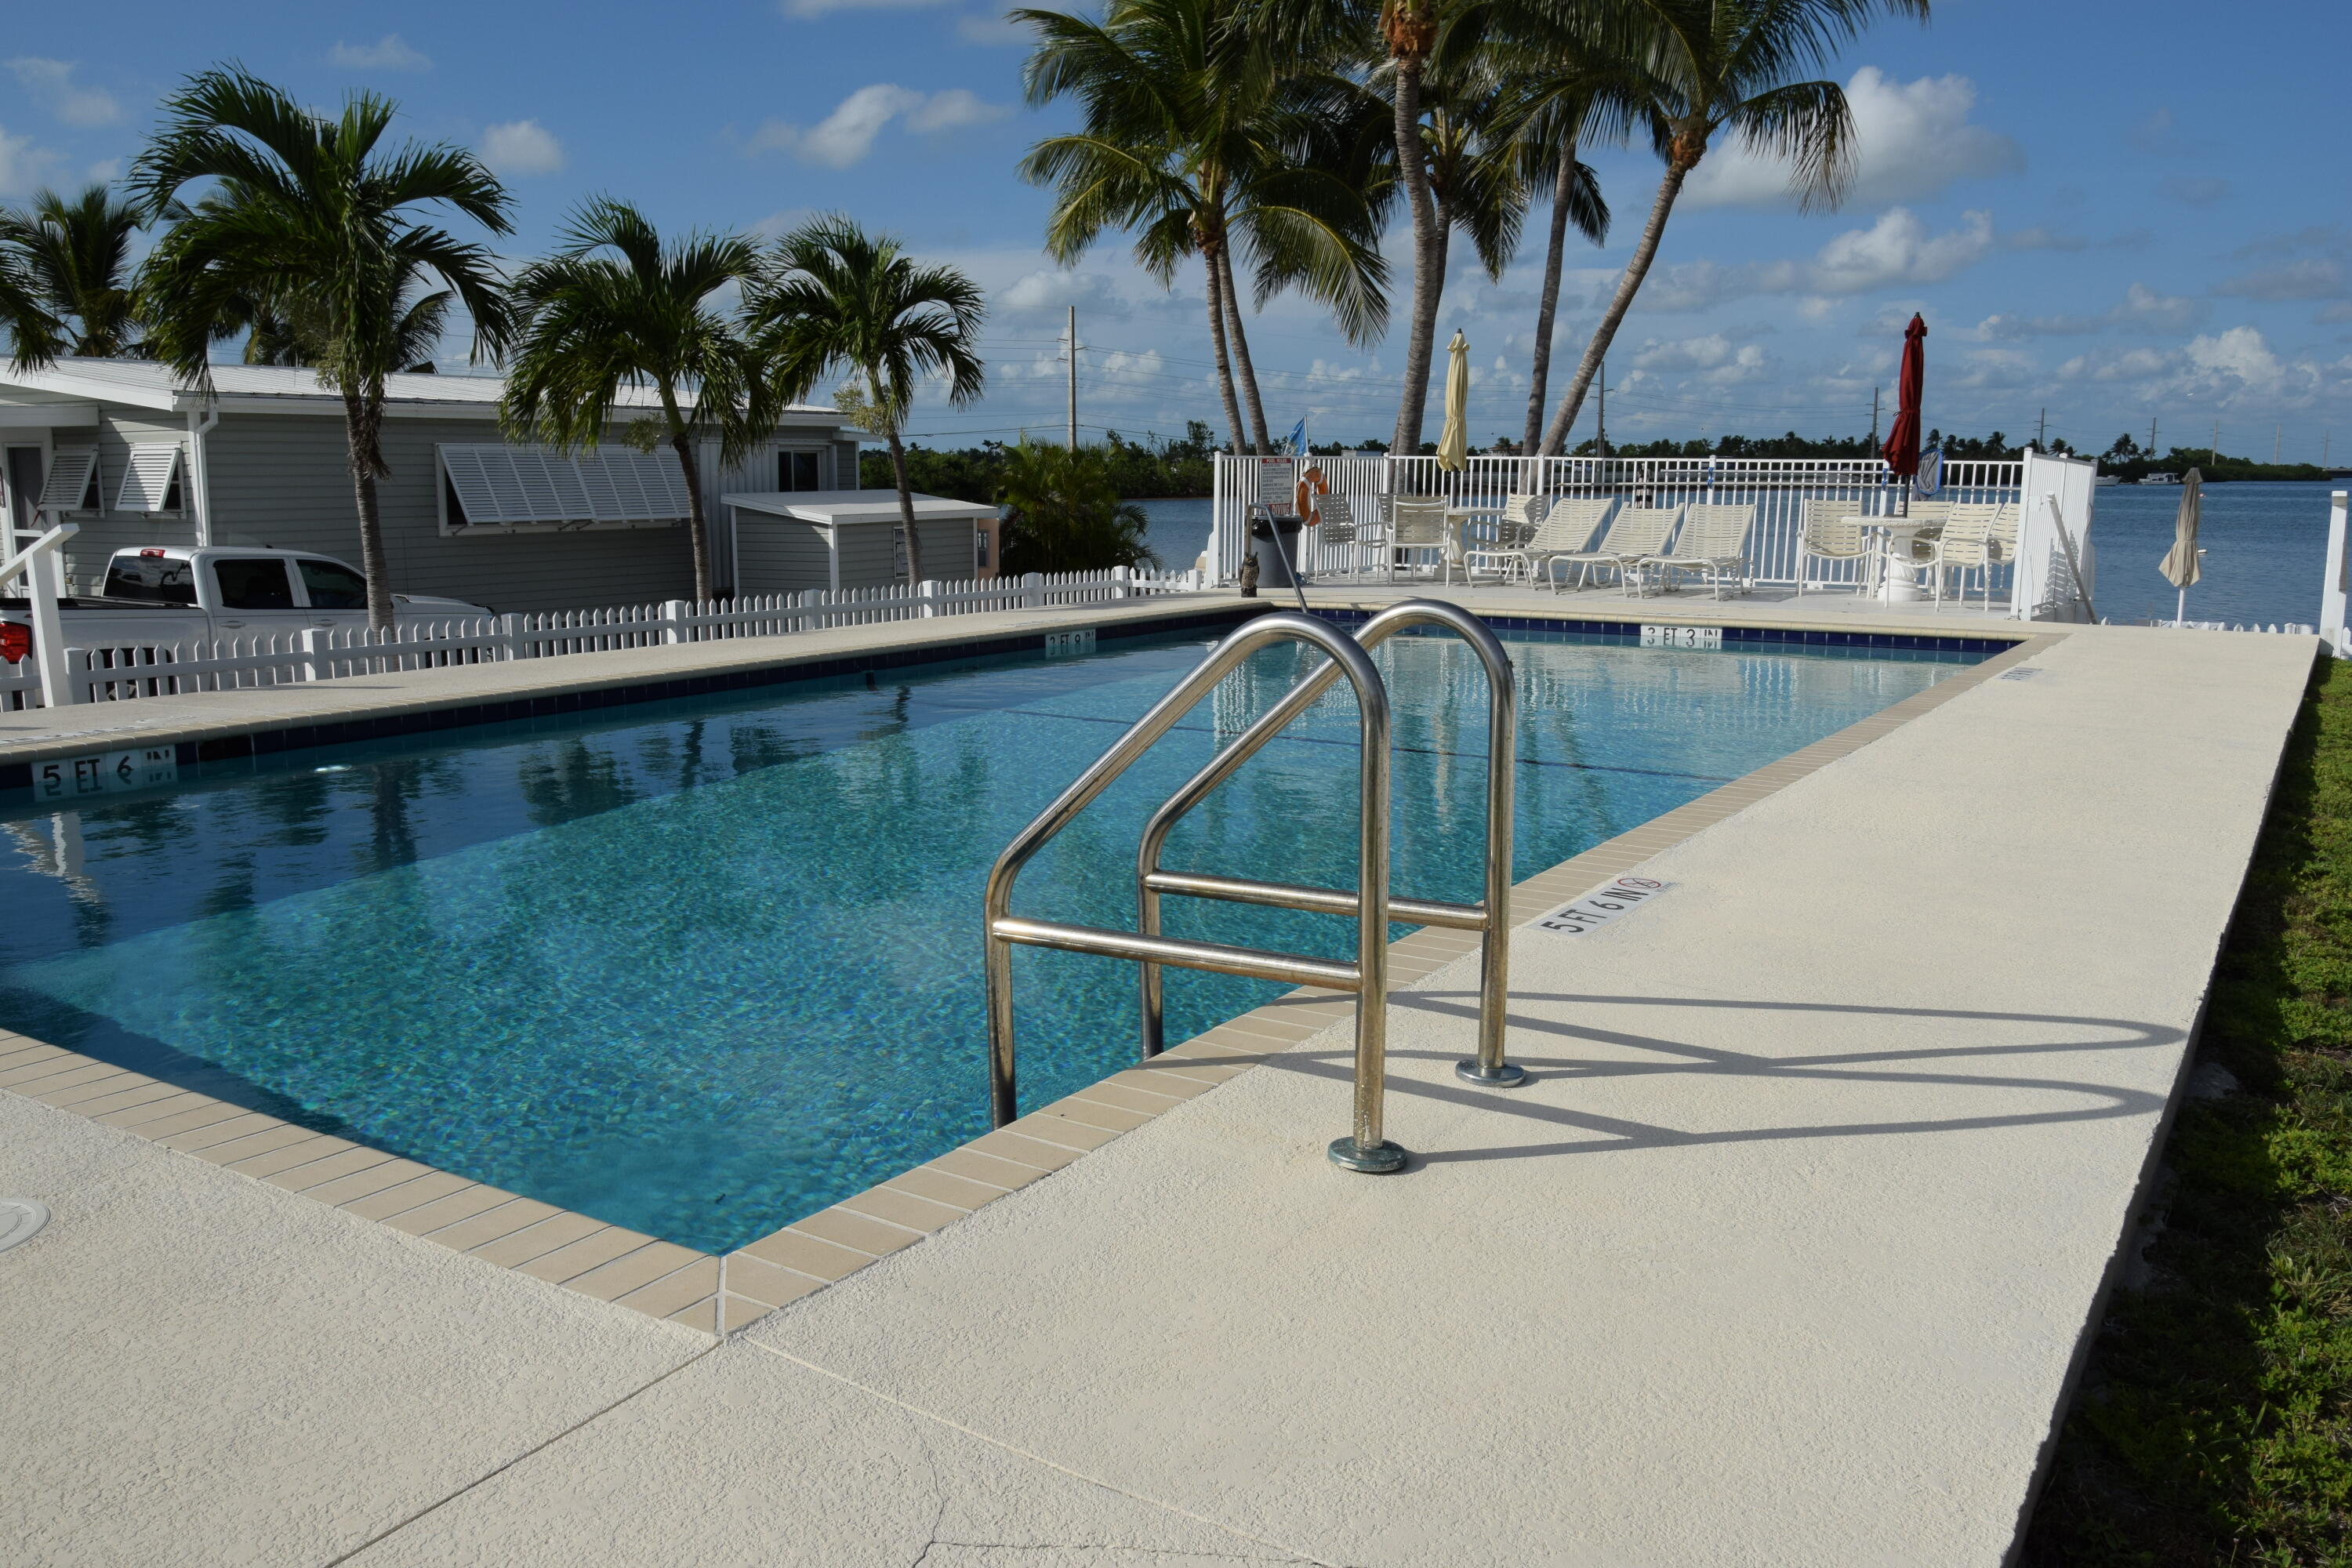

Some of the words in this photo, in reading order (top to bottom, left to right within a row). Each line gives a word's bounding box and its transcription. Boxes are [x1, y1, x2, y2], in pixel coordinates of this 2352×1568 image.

[1272, 503, 1290, 514] DIVING
[1664, 628, 1678, 637] FT
[1060, 633, 1069, 644] FT
[43, 764, 61, 784] 5
[75, 758, 100, 778] FT
[117, 755, 133, 773] 6
[147, 749, 169, 760] IN
[1600, 887, 1649, 902] IN
[1588, 900, 1624, 910] 6
[1557, 909, 1607, 924] FT
[1541, 921, 1584, 933] 5
